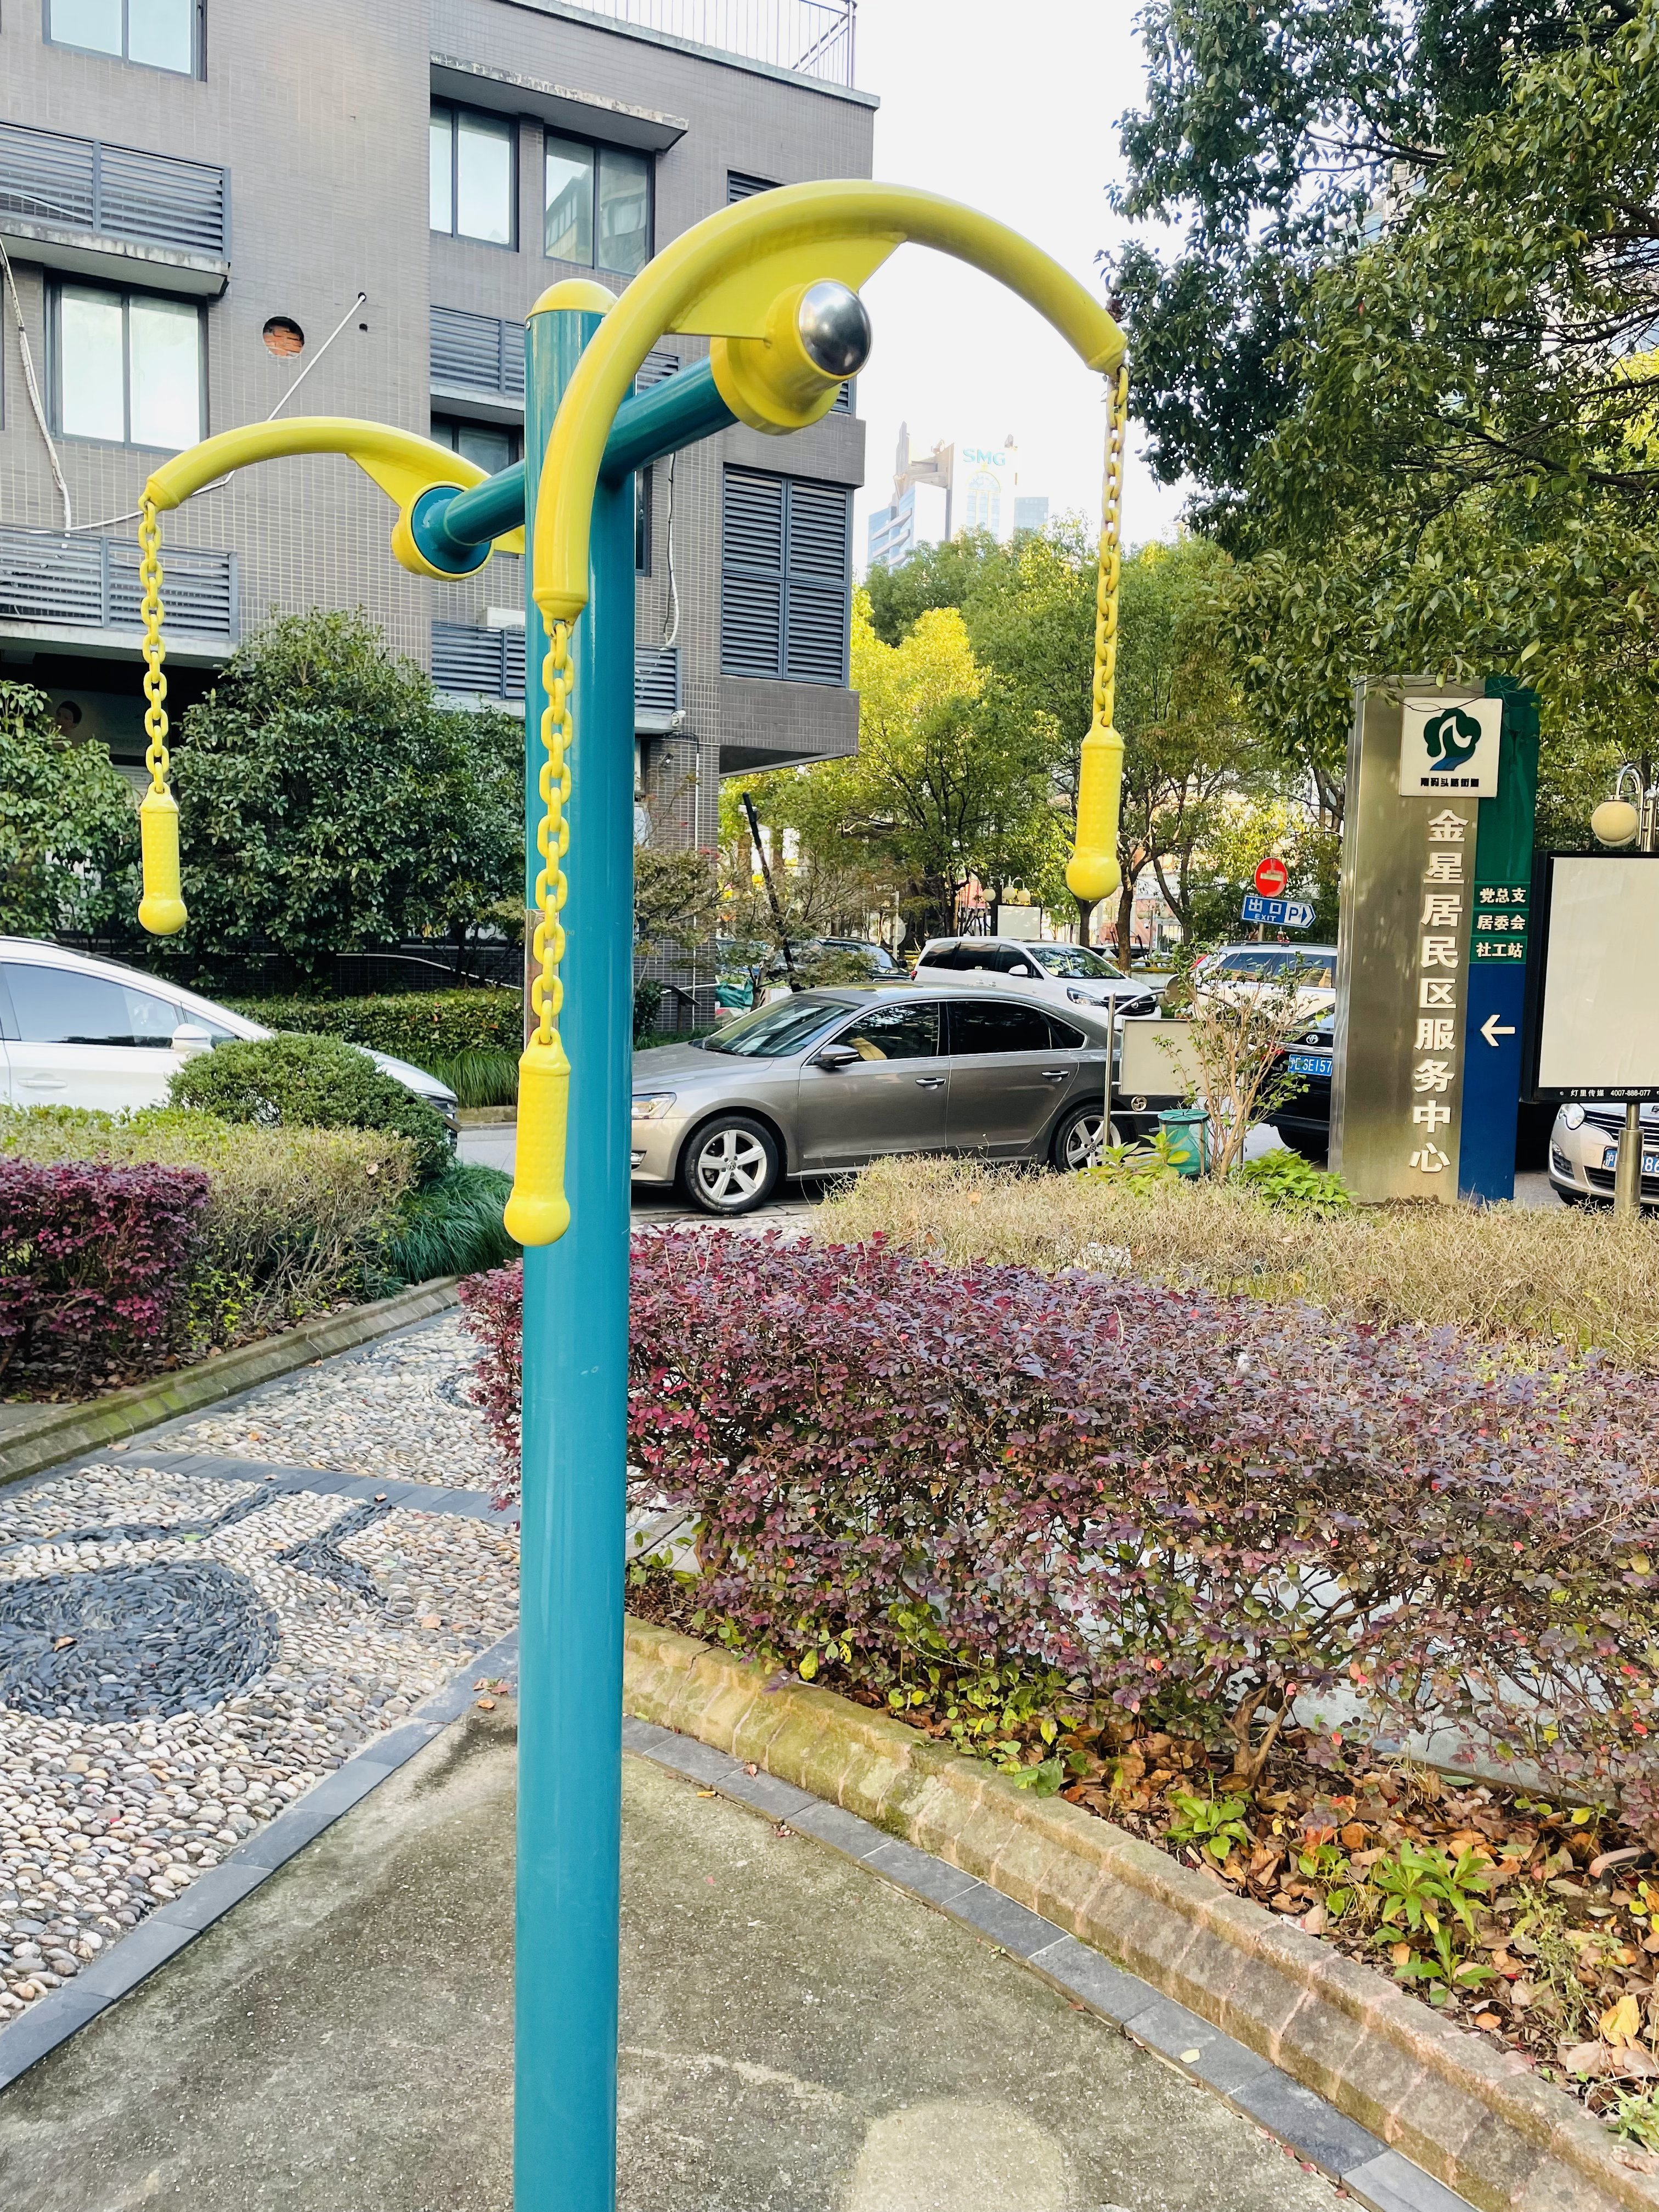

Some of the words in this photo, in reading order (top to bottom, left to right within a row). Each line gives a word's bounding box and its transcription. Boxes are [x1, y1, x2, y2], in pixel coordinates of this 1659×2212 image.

[963, 448, 1006, 466] SMG
[1480, 887, 1526, 903] 党总支
[1248, 899, 1282, 915] 出口
[1254, 913, 1277, 922] EXIT
[1477, 915, 1526, 930] 居委会
[1476, 942, 1523, 958] 社工站
[1409, 809, 1469, 1172] 金星居民区服务中心
